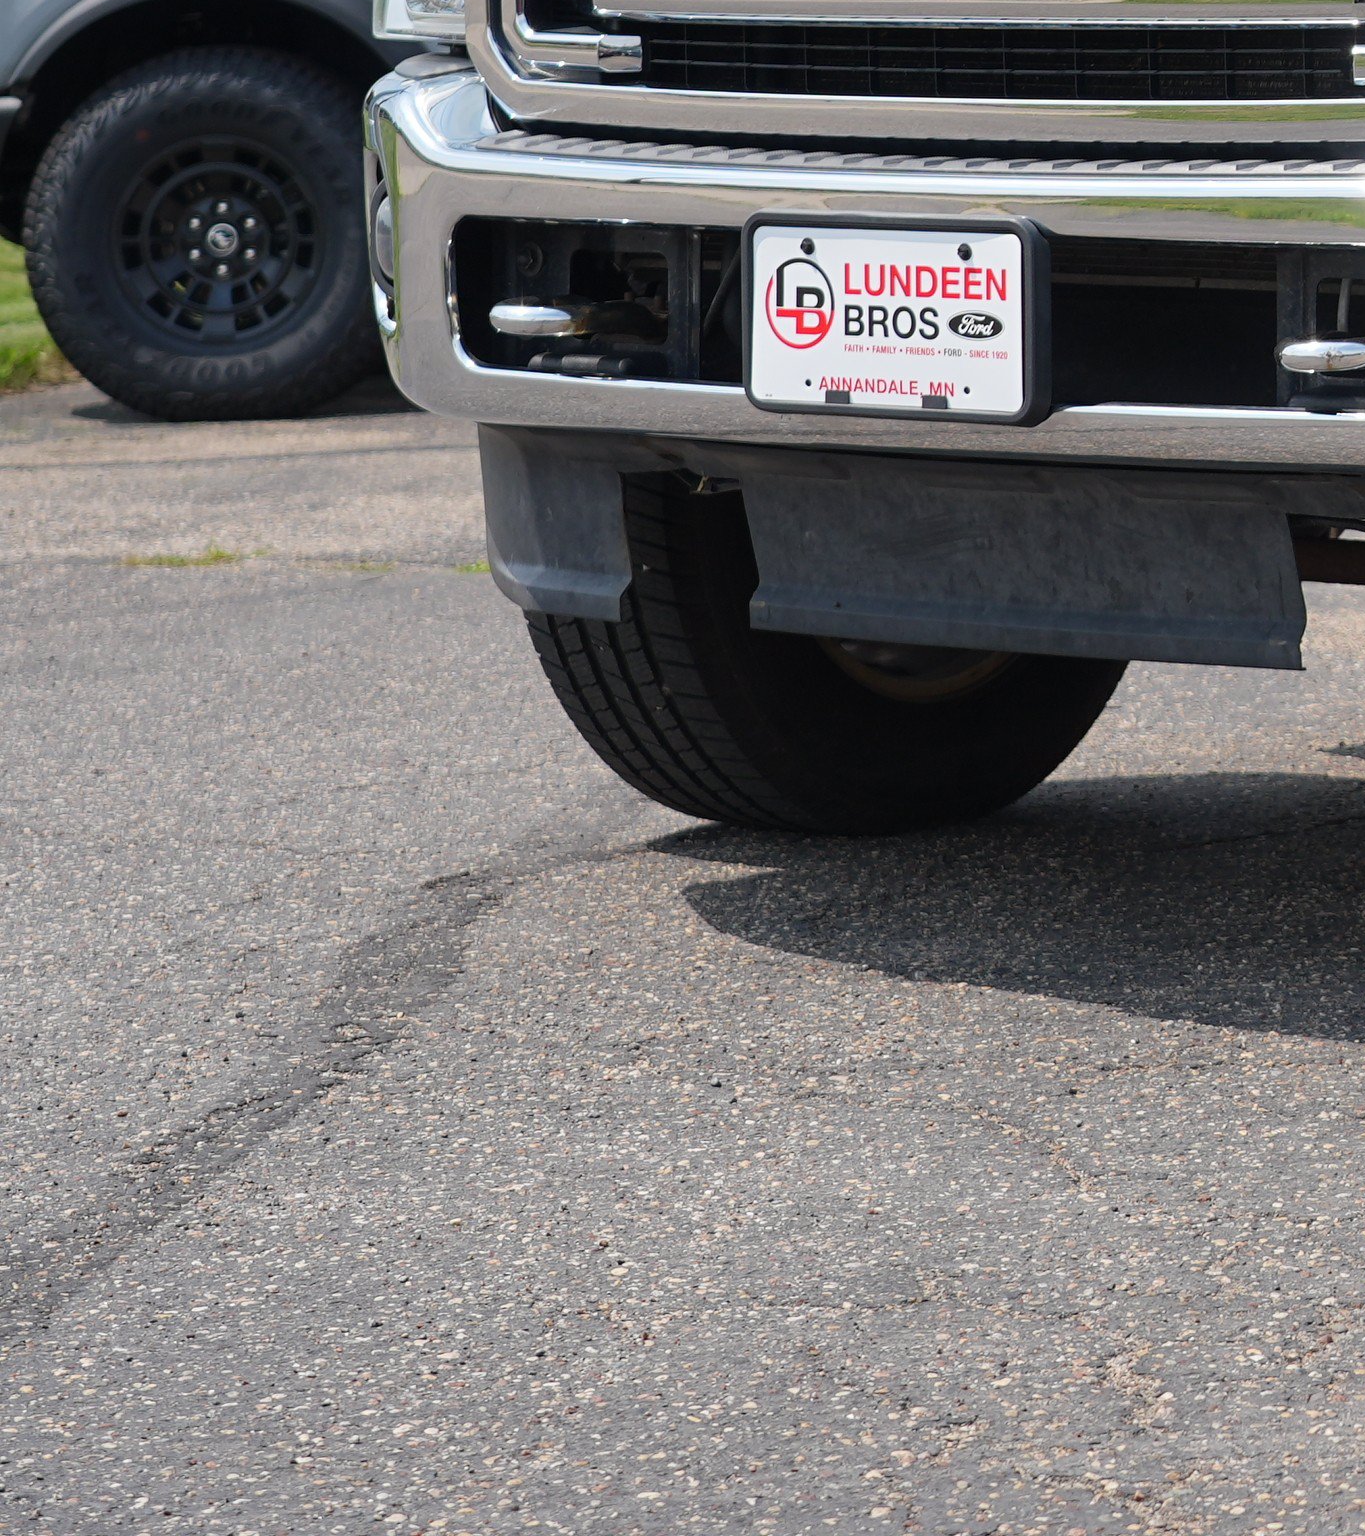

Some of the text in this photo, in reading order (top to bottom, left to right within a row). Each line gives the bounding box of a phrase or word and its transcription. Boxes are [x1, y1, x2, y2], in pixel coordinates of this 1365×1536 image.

[844, 262, 1007, 301] LUNDEEN
[844, 304, 939, 340] BROS
[957, 314, 994, 337] Ford
[844, 343, 1008, 360] FAITH FAMILY FRIENDS FORD SINCE 1920
[819, 375, 955, 397] ANNANDALE, MN
